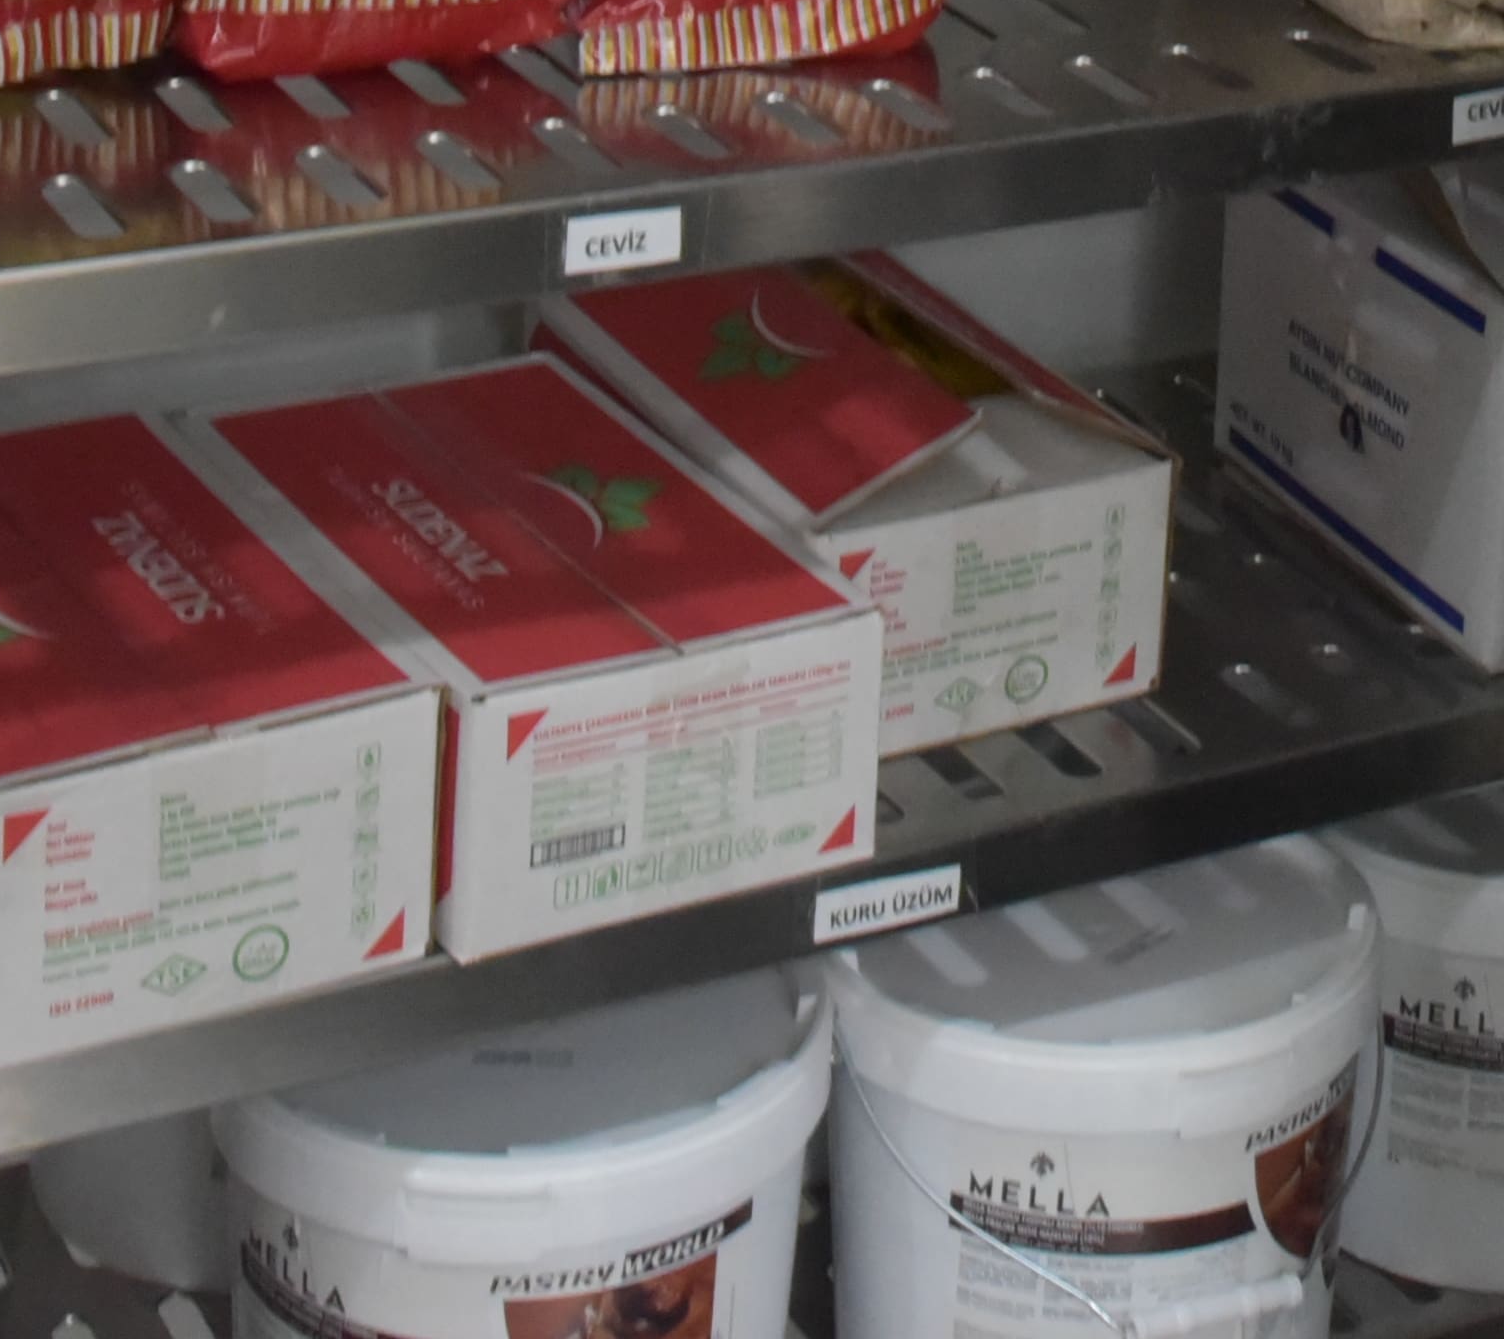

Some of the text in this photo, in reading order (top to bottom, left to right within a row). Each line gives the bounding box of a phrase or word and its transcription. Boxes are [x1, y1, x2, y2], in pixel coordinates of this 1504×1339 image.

[584, 228, 648, 259] CEVİZ
[1345, 363, 1410, 417] COMPANY
[830, 883, 953, 929] KURU ÜZÜM
[1246, 1096, 1324, 1152] PASTRY
[969, 1171, 1110, 1217] MELLA
[248, 1227, 345, 1313] MELLA
[490, 1219, 726, 1295] PASTRY WORLD
